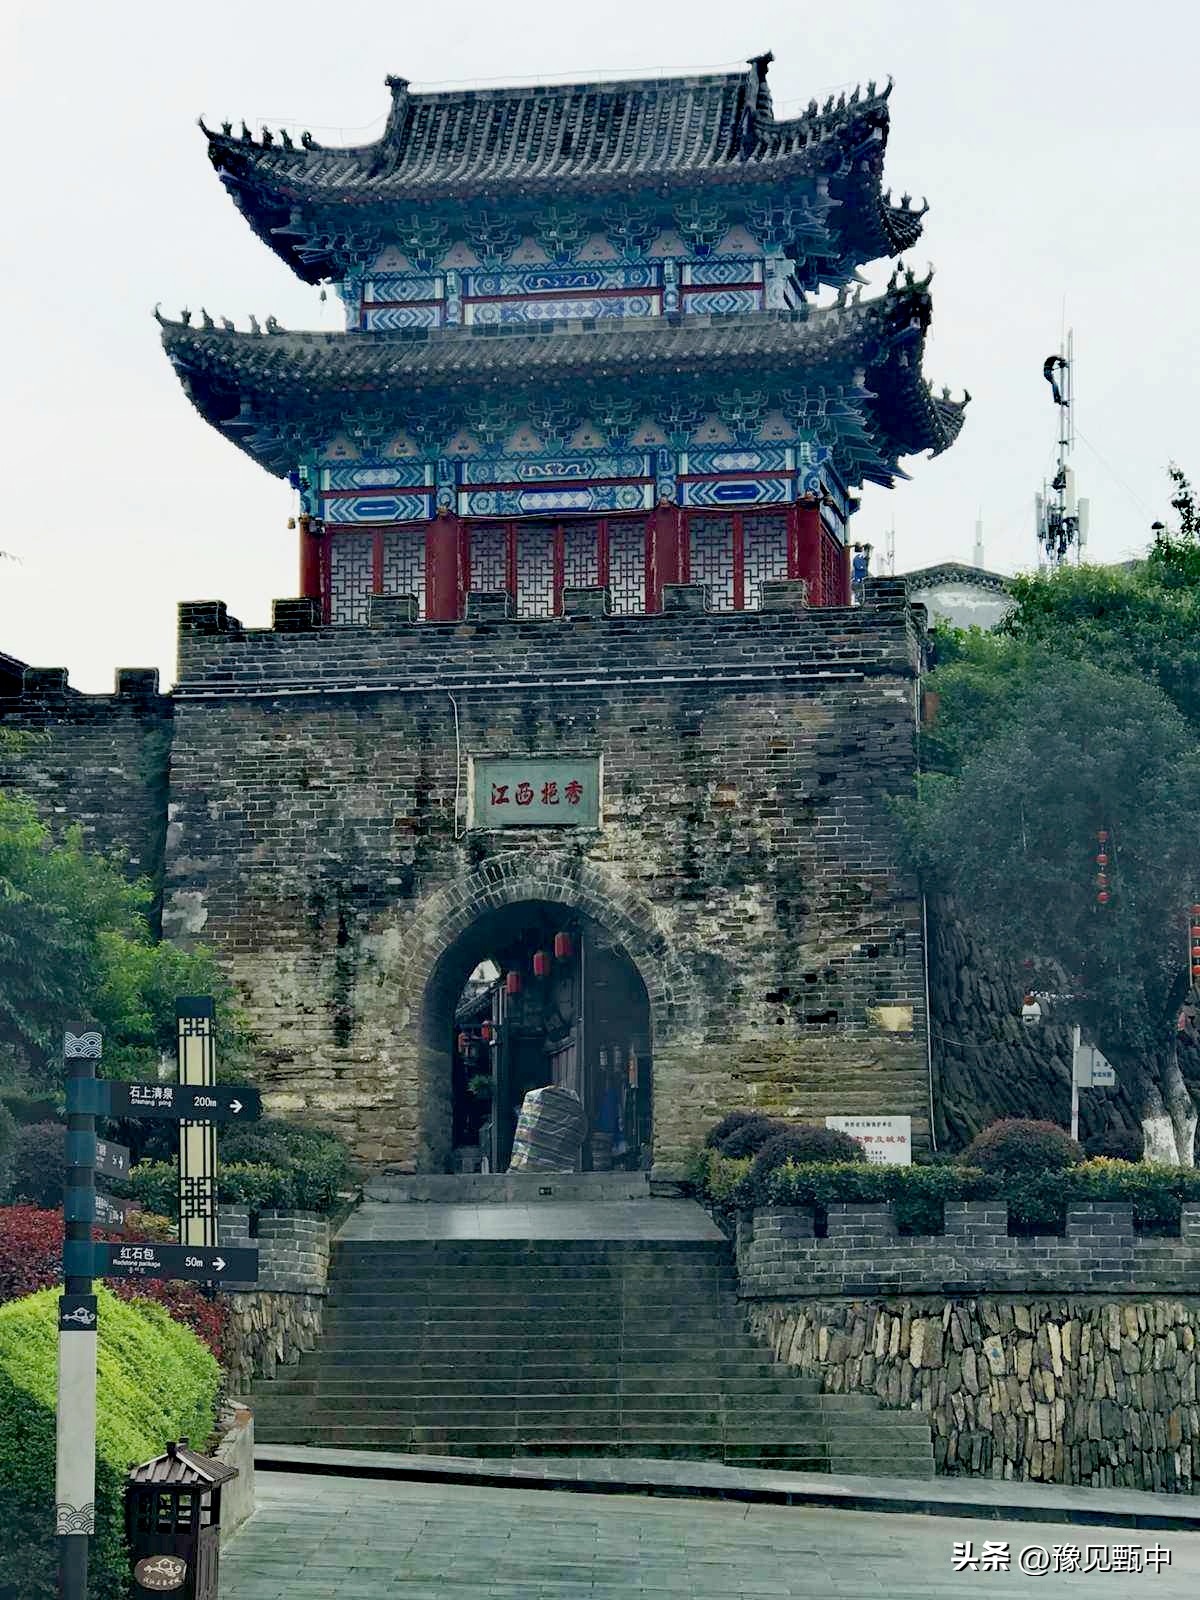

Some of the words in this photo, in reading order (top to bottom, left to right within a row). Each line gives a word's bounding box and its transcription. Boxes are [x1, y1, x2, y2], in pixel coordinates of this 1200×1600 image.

[129, 1085, 174, 1100] 石上清泉
[193, 1096, 217, 1107] 200m
[120, 1246, 154, 1260] 红石包
[184, 1256, 204, 1268] 50m
